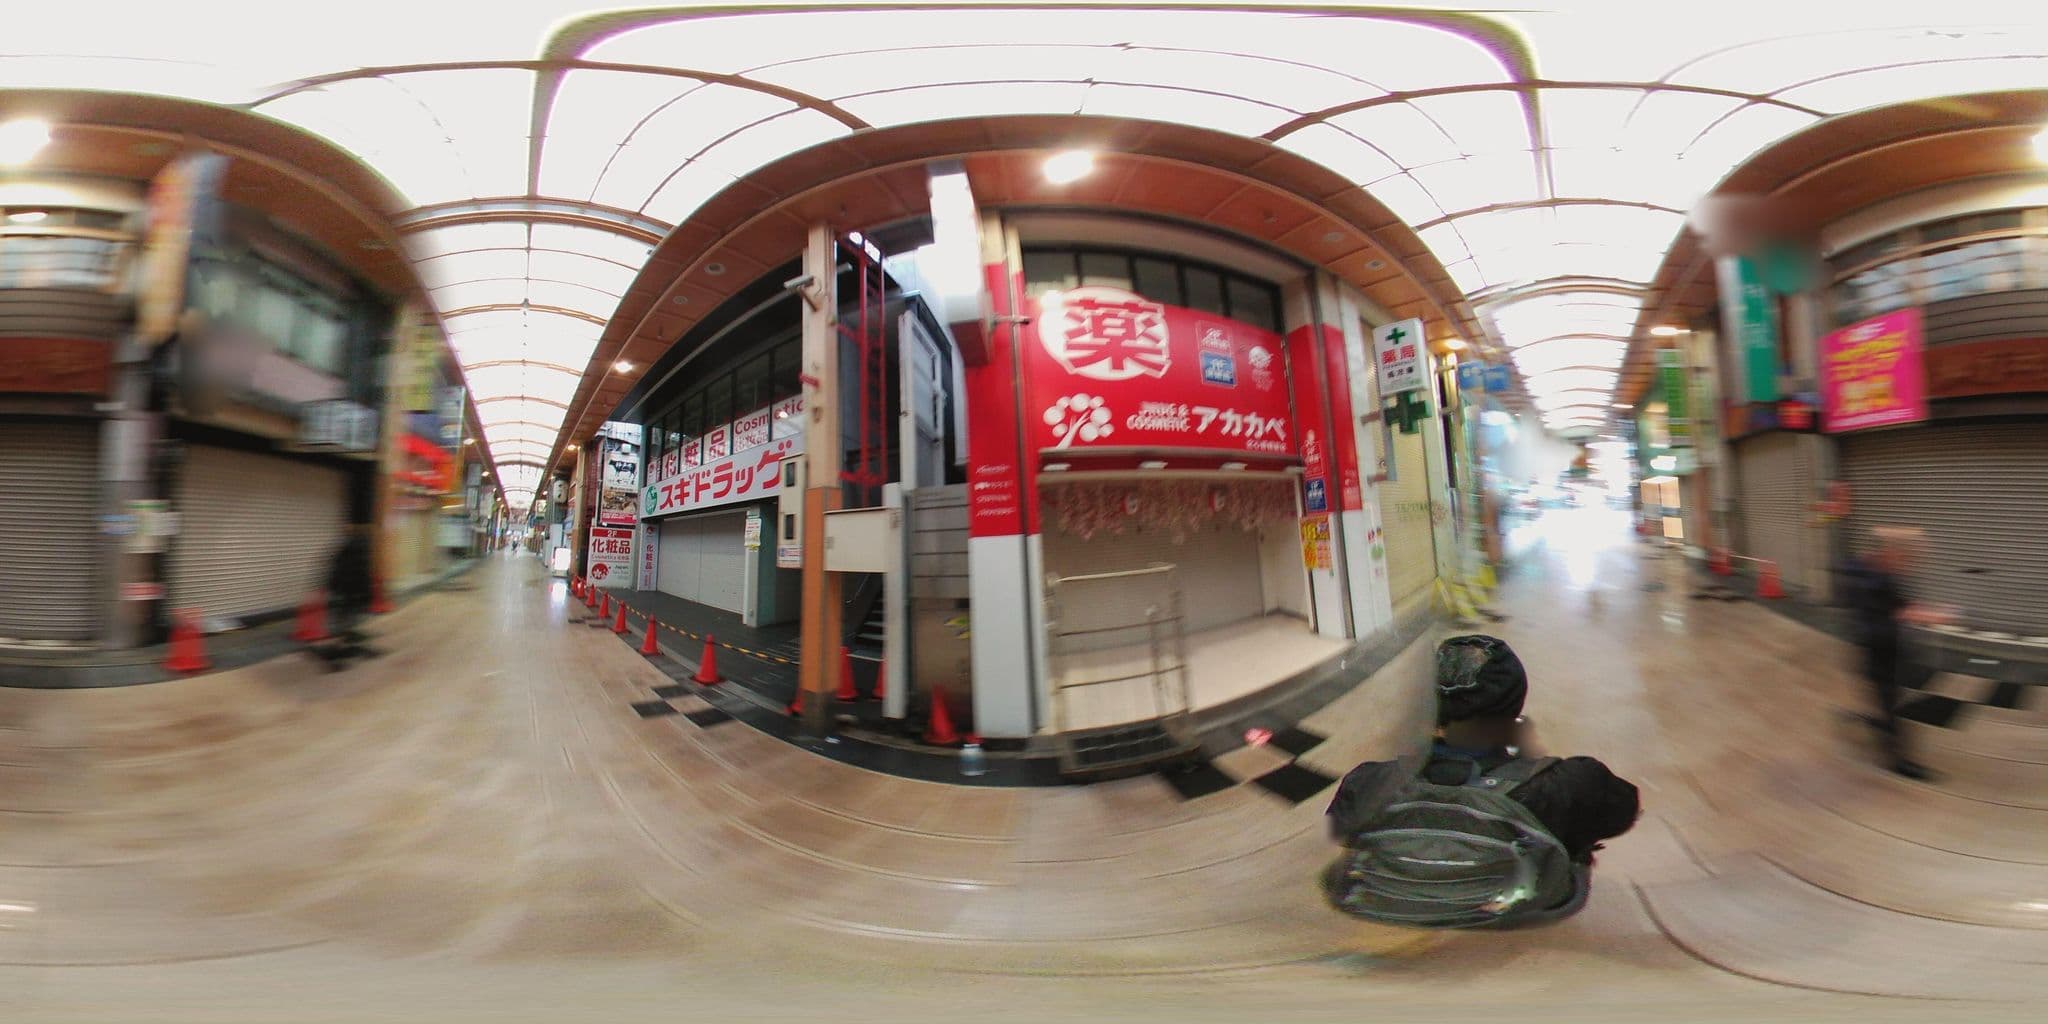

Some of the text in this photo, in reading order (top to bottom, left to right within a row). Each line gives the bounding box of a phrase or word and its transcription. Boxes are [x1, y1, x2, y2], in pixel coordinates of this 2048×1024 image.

[1062, 298, 1167, 372] 薬
[1382, 344, 1415, 364] 薬局
[1191, 405, 1286, 441] アカカベ
[665, 429, 725, 477] 化粧品
[659, 439, 793, 510] スギドラッグ
[591, 538, 631, 554] 化粧品
[607, 529, 617, 537] 2F
[645, 543, 654, 570] 化粧品
